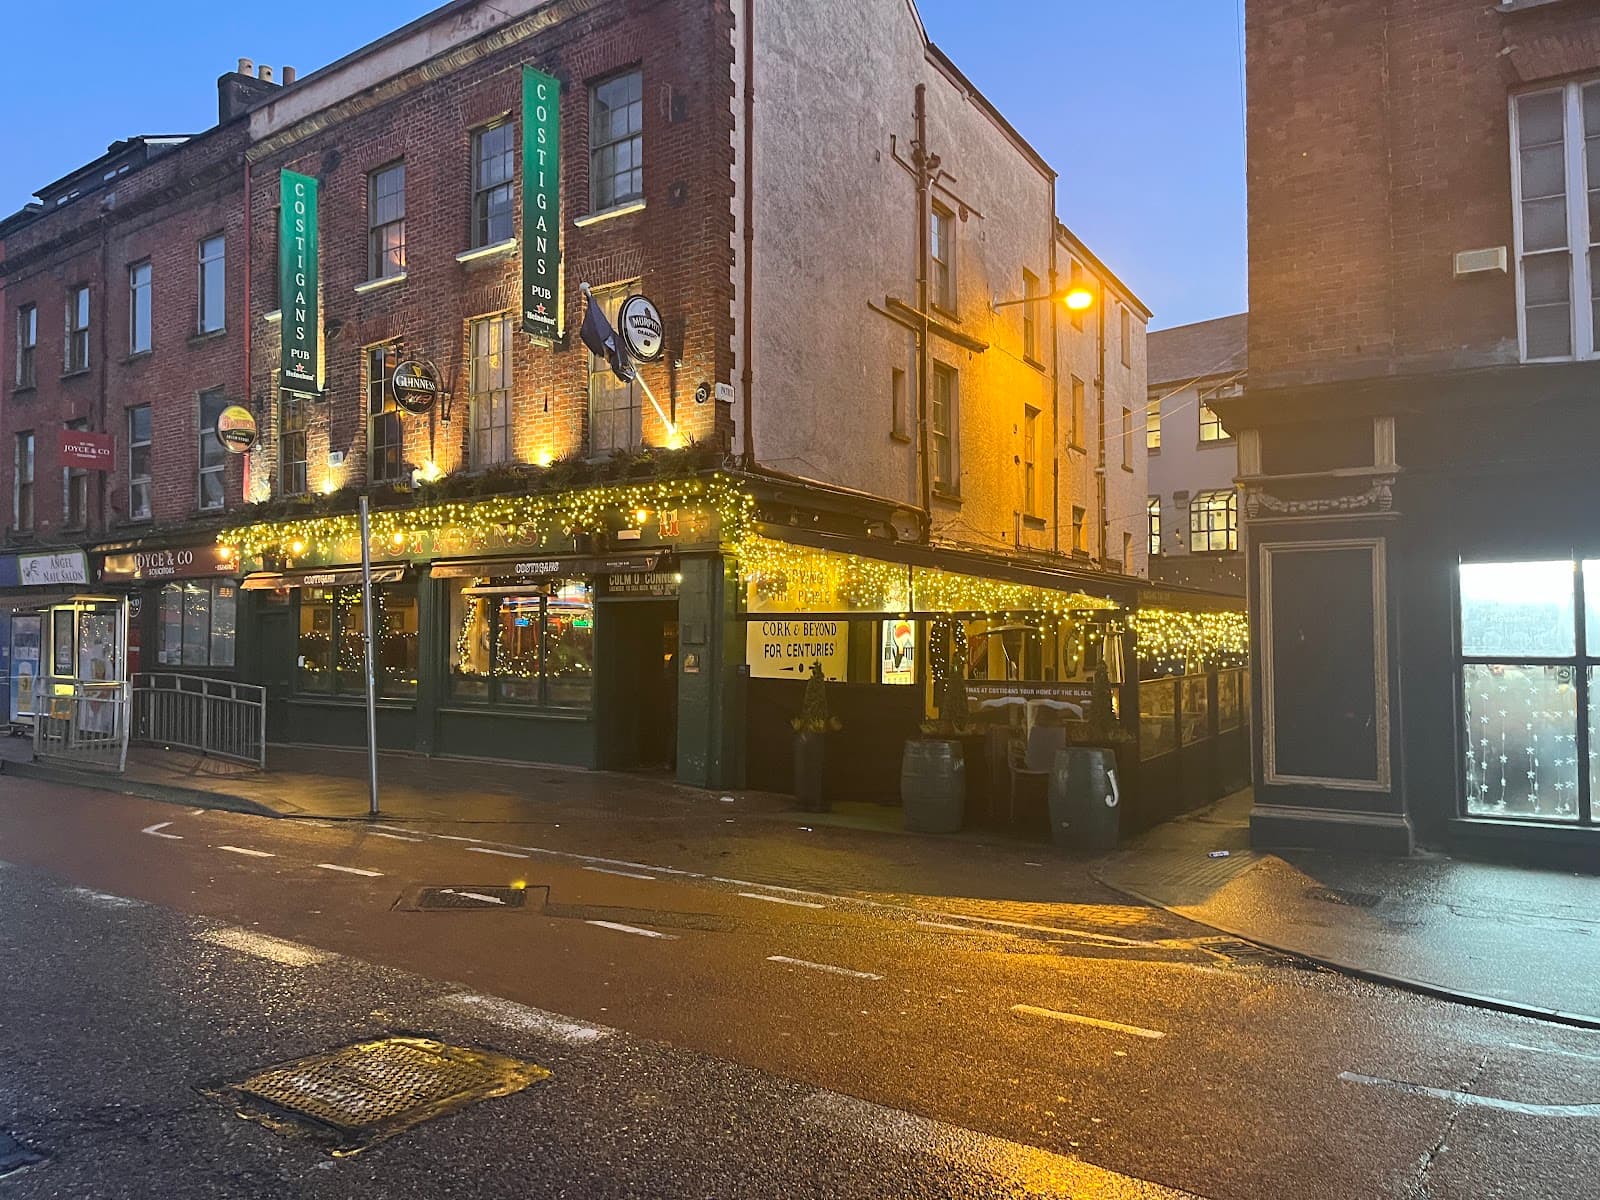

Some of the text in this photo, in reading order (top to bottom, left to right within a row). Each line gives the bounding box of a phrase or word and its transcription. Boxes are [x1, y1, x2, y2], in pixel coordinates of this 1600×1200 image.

[536, 84, 547, 275] COSTIGANS
[294, 183, 306, 340] COSTIGANS
[531, 285, 552, 299] PUB
[527, 310, 556, 326] Heineken
[290, 348, 310, 360] PUB
[395, 375, 436, 391] GUINNESS
[63, 444, 90, 454] JOYCE
[97, 448, 110, 456] CO
[658, 508, 680, 537] 11
[49, 557, 73, 569] ANGEL
[167, 553, 175, 566] &
[177, 551, 193, 565] CO
[43, 570, 84, 583] NAIL SALON
[762, 621, 837, 637] CORK & BEYOND
[764, 643, 834, 659] FOR CENTURIES
